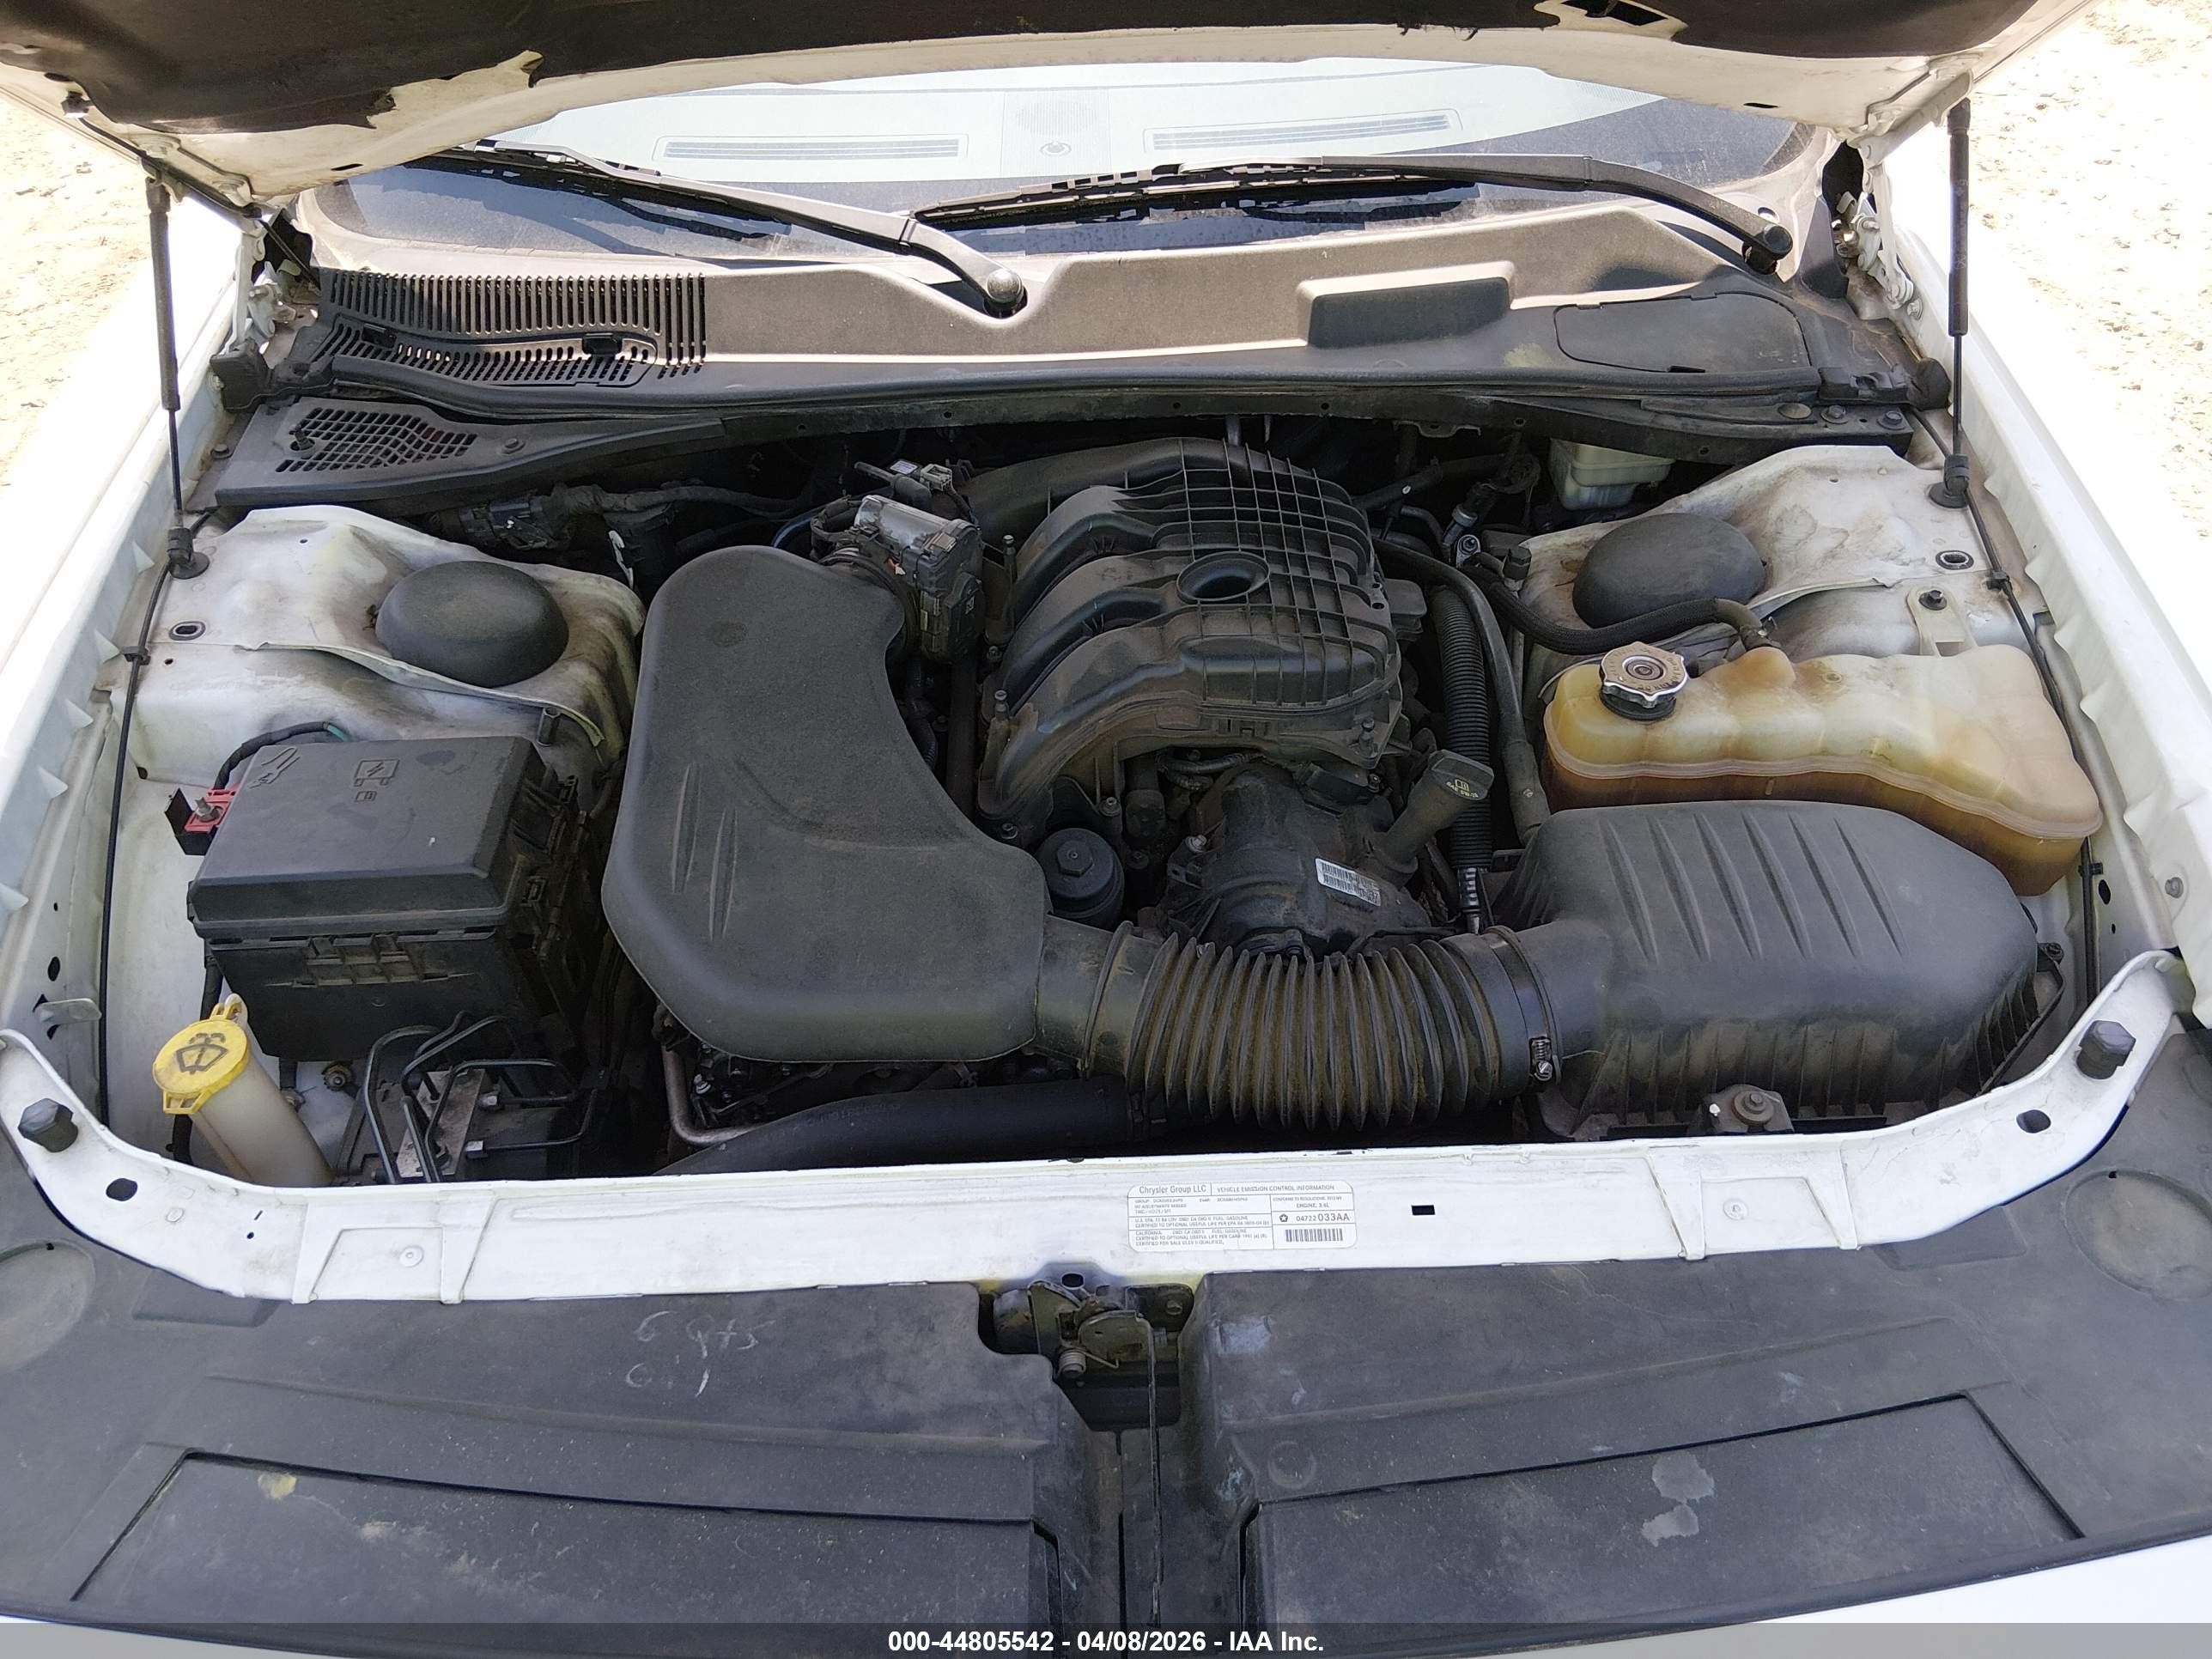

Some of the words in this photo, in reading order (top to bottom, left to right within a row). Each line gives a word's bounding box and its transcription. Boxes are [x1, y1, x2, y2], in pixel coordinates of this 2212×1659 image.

[1139, 1186, 1168, 1196] Chrysler
[1170, 1185, 1191, 1194] Group
[1193, 1184, 1206, 1193] LLC
